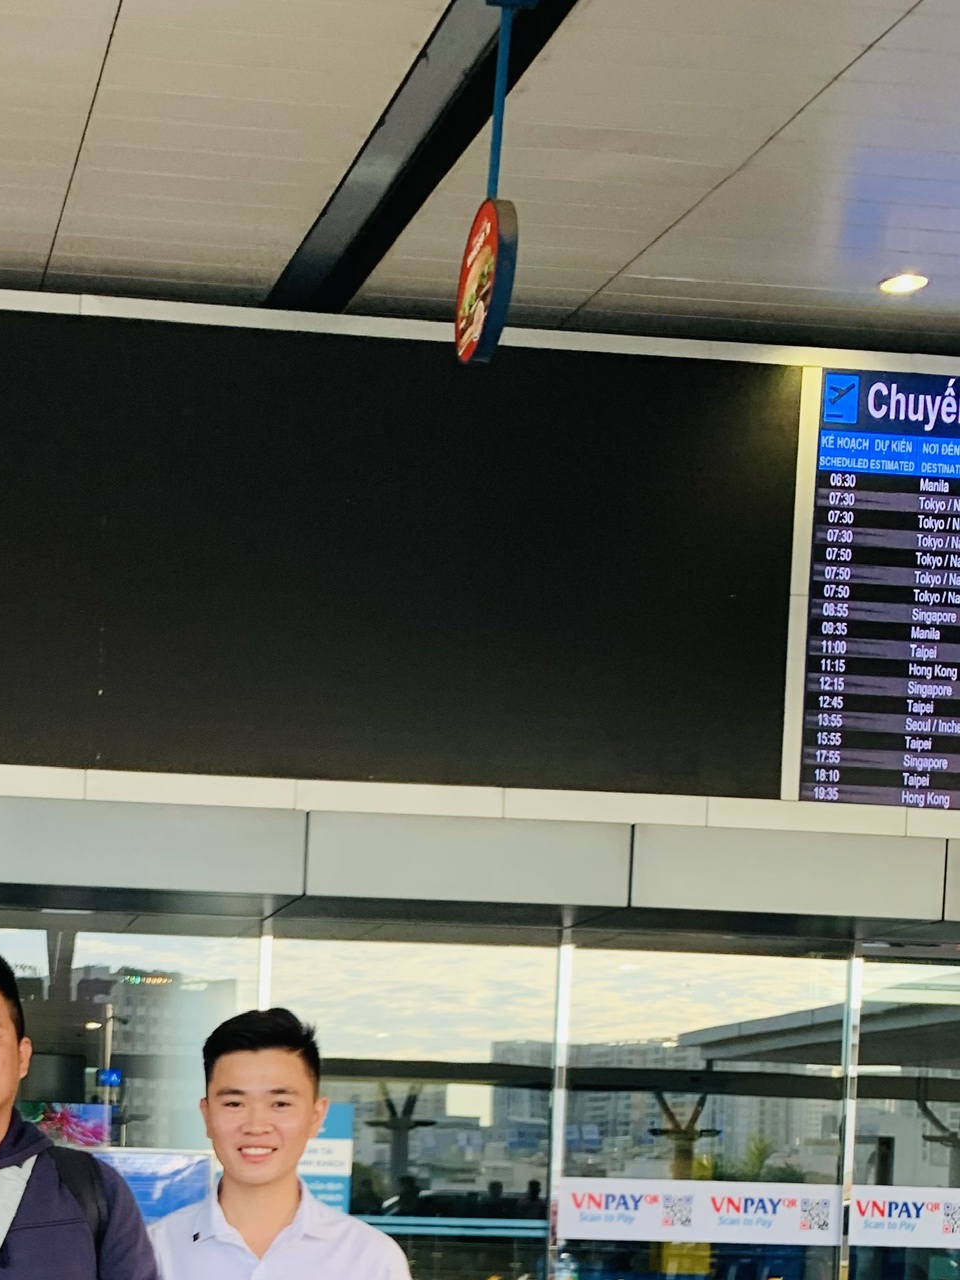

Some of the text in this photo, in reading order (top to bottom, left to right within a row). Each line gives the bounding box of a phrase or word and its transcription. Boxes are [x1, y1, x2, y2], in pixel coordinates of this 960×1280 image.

[868, 379, 960, 431] Chuyế
[837, 437, 869, 452] HOẠCH
[820, 456, 869, 468] SCHEDULED
[870, 459, 915, 471] ESTIMATED
[920, 478, 949, 492] Manila
[829, 492, 855, 506] 07:30
[919, 496, 946, 513] Tokyo
[828, 510, 854, 524] 07:30
[918, 515, 945, 532] Tokyo
[827, 529, 853, 543] 07:30
[917, 534, 944, 550] Tokyo
[826, 548, 852, 561] 07:50
[916, 552, 943, 569] Tokyo
[825, 566, 851, 580] 07:50
[915, 571, 941, 587] Tokyo
[824, 585, 850, 598] 07:50
[913, 589, 940, 605] Tokyo
[823, 603, 957, 625] 08:55 Singapore
[822, 622, 940, 640] 09:35 Manila
[821, 640, 937, 661] 11:00 Taipei
[821, 659, 958, 681] 11:15 Hong Kong
[820, 677, 952, 698] 12:15 Singapore
[819, 696, 934, 715] 12:45 Taipei
[818, 714, 843, 728] 13:55
[905, 718, 931, 732] Seoul
[817, 732, 932, 752] 15:55 Taipei
[816, 750, 948, 771] 17:55 Singapore
[814, 769, 930, 789] 18:10 Taipei
[814, 787, 950, 809] 19:35 Hong Kong
[579, 1212, 635, 1225] Scan to Pay
[718, 1216, 773, 1229] Scan to Pay
[863, 1220, 917, 1232] Scan to Pay
